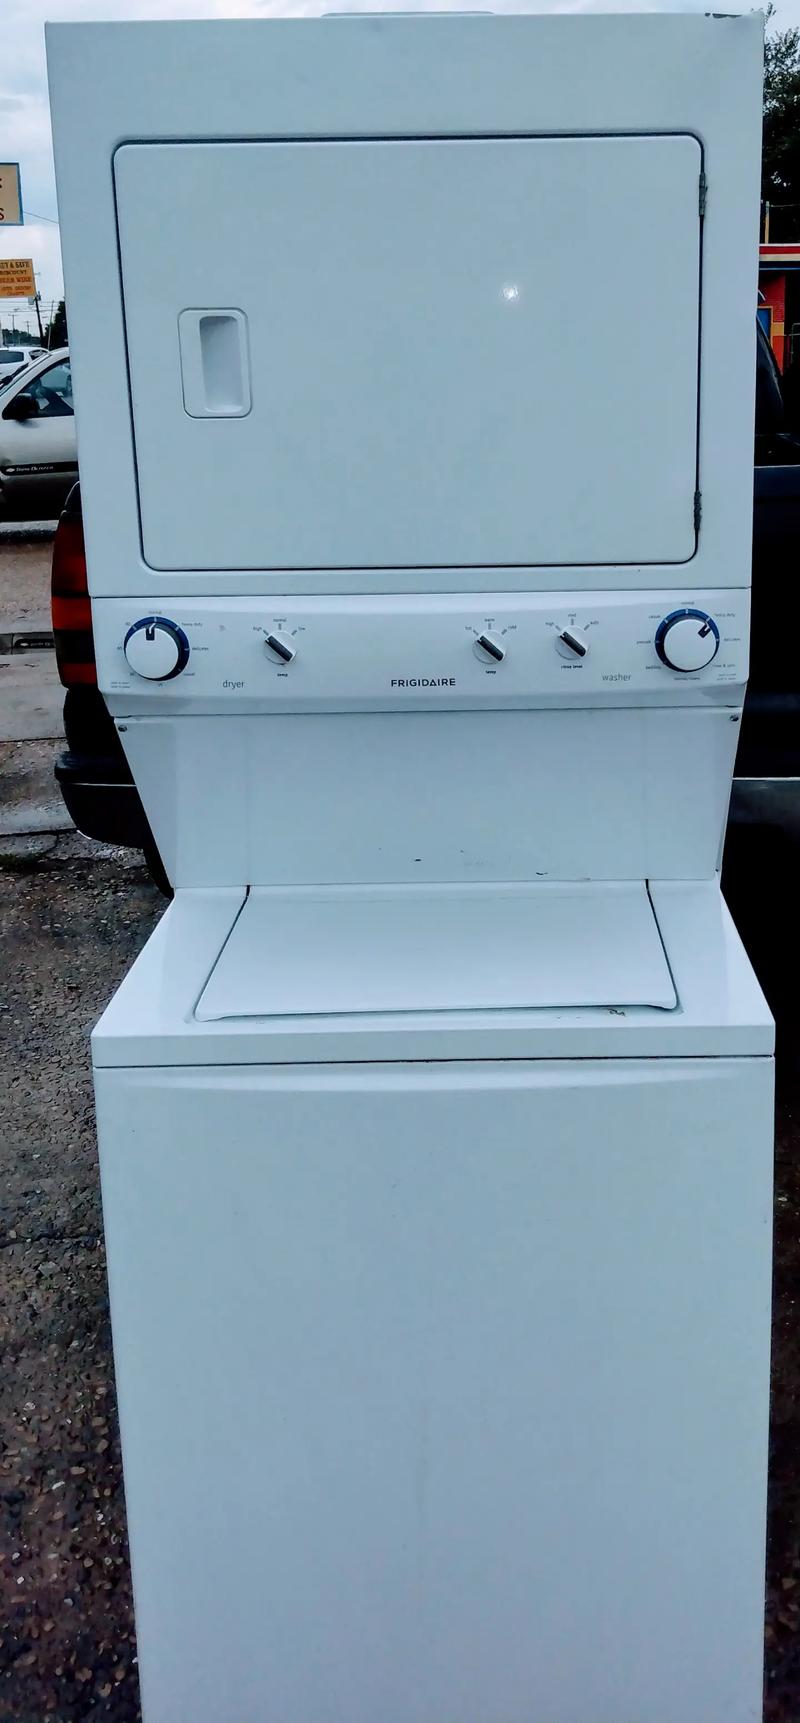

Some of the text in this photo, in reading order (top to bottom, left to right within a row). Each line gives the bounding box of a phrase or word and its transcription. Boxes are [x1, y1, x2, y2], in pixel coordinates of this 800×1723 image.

[602, 673, 632, 682] washer
[222, 680, 245, 690] dryer
[391, 678, 456, 687] FRIGIDAIRE
